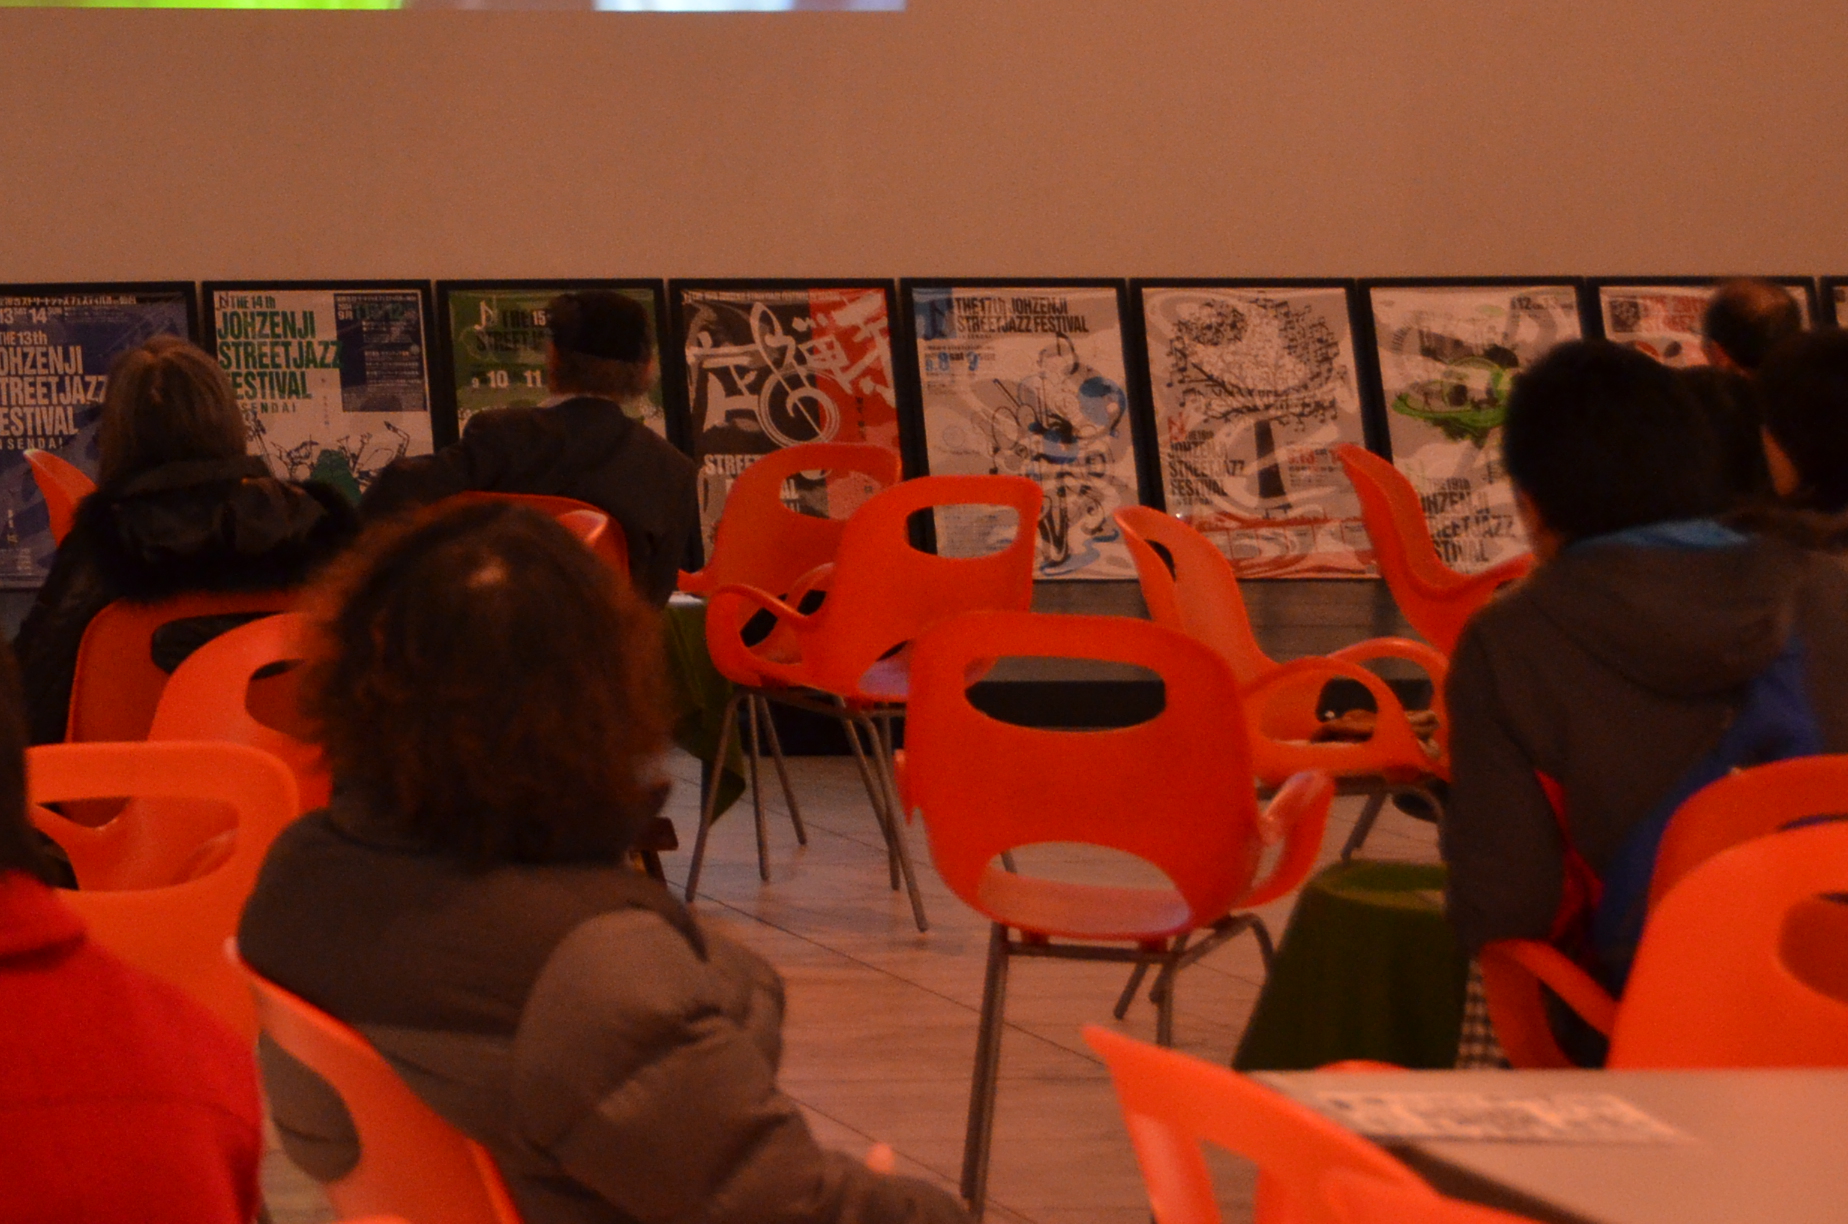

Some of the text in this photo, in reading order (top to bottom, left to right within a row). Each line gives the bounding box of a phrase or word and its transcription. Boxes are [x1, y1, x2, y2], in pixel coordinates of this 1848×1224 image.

[231, 295, 249, 309] THE
[1009, 296, 1069, 315] JOHZENJI
[28, 307, 48, 324] 14
[1033, 315, 1090, 333] FESTIVAL
[217, 310, 316, 340] JOHZENJI
[17, 330, 48, 345] 13th
[231, 370, 311, 400] ESTIVAL
[486, 370, 509, 389] 10
[523, 370, 543, 388] 11
[6, 437, 64, 450] SENDAI
